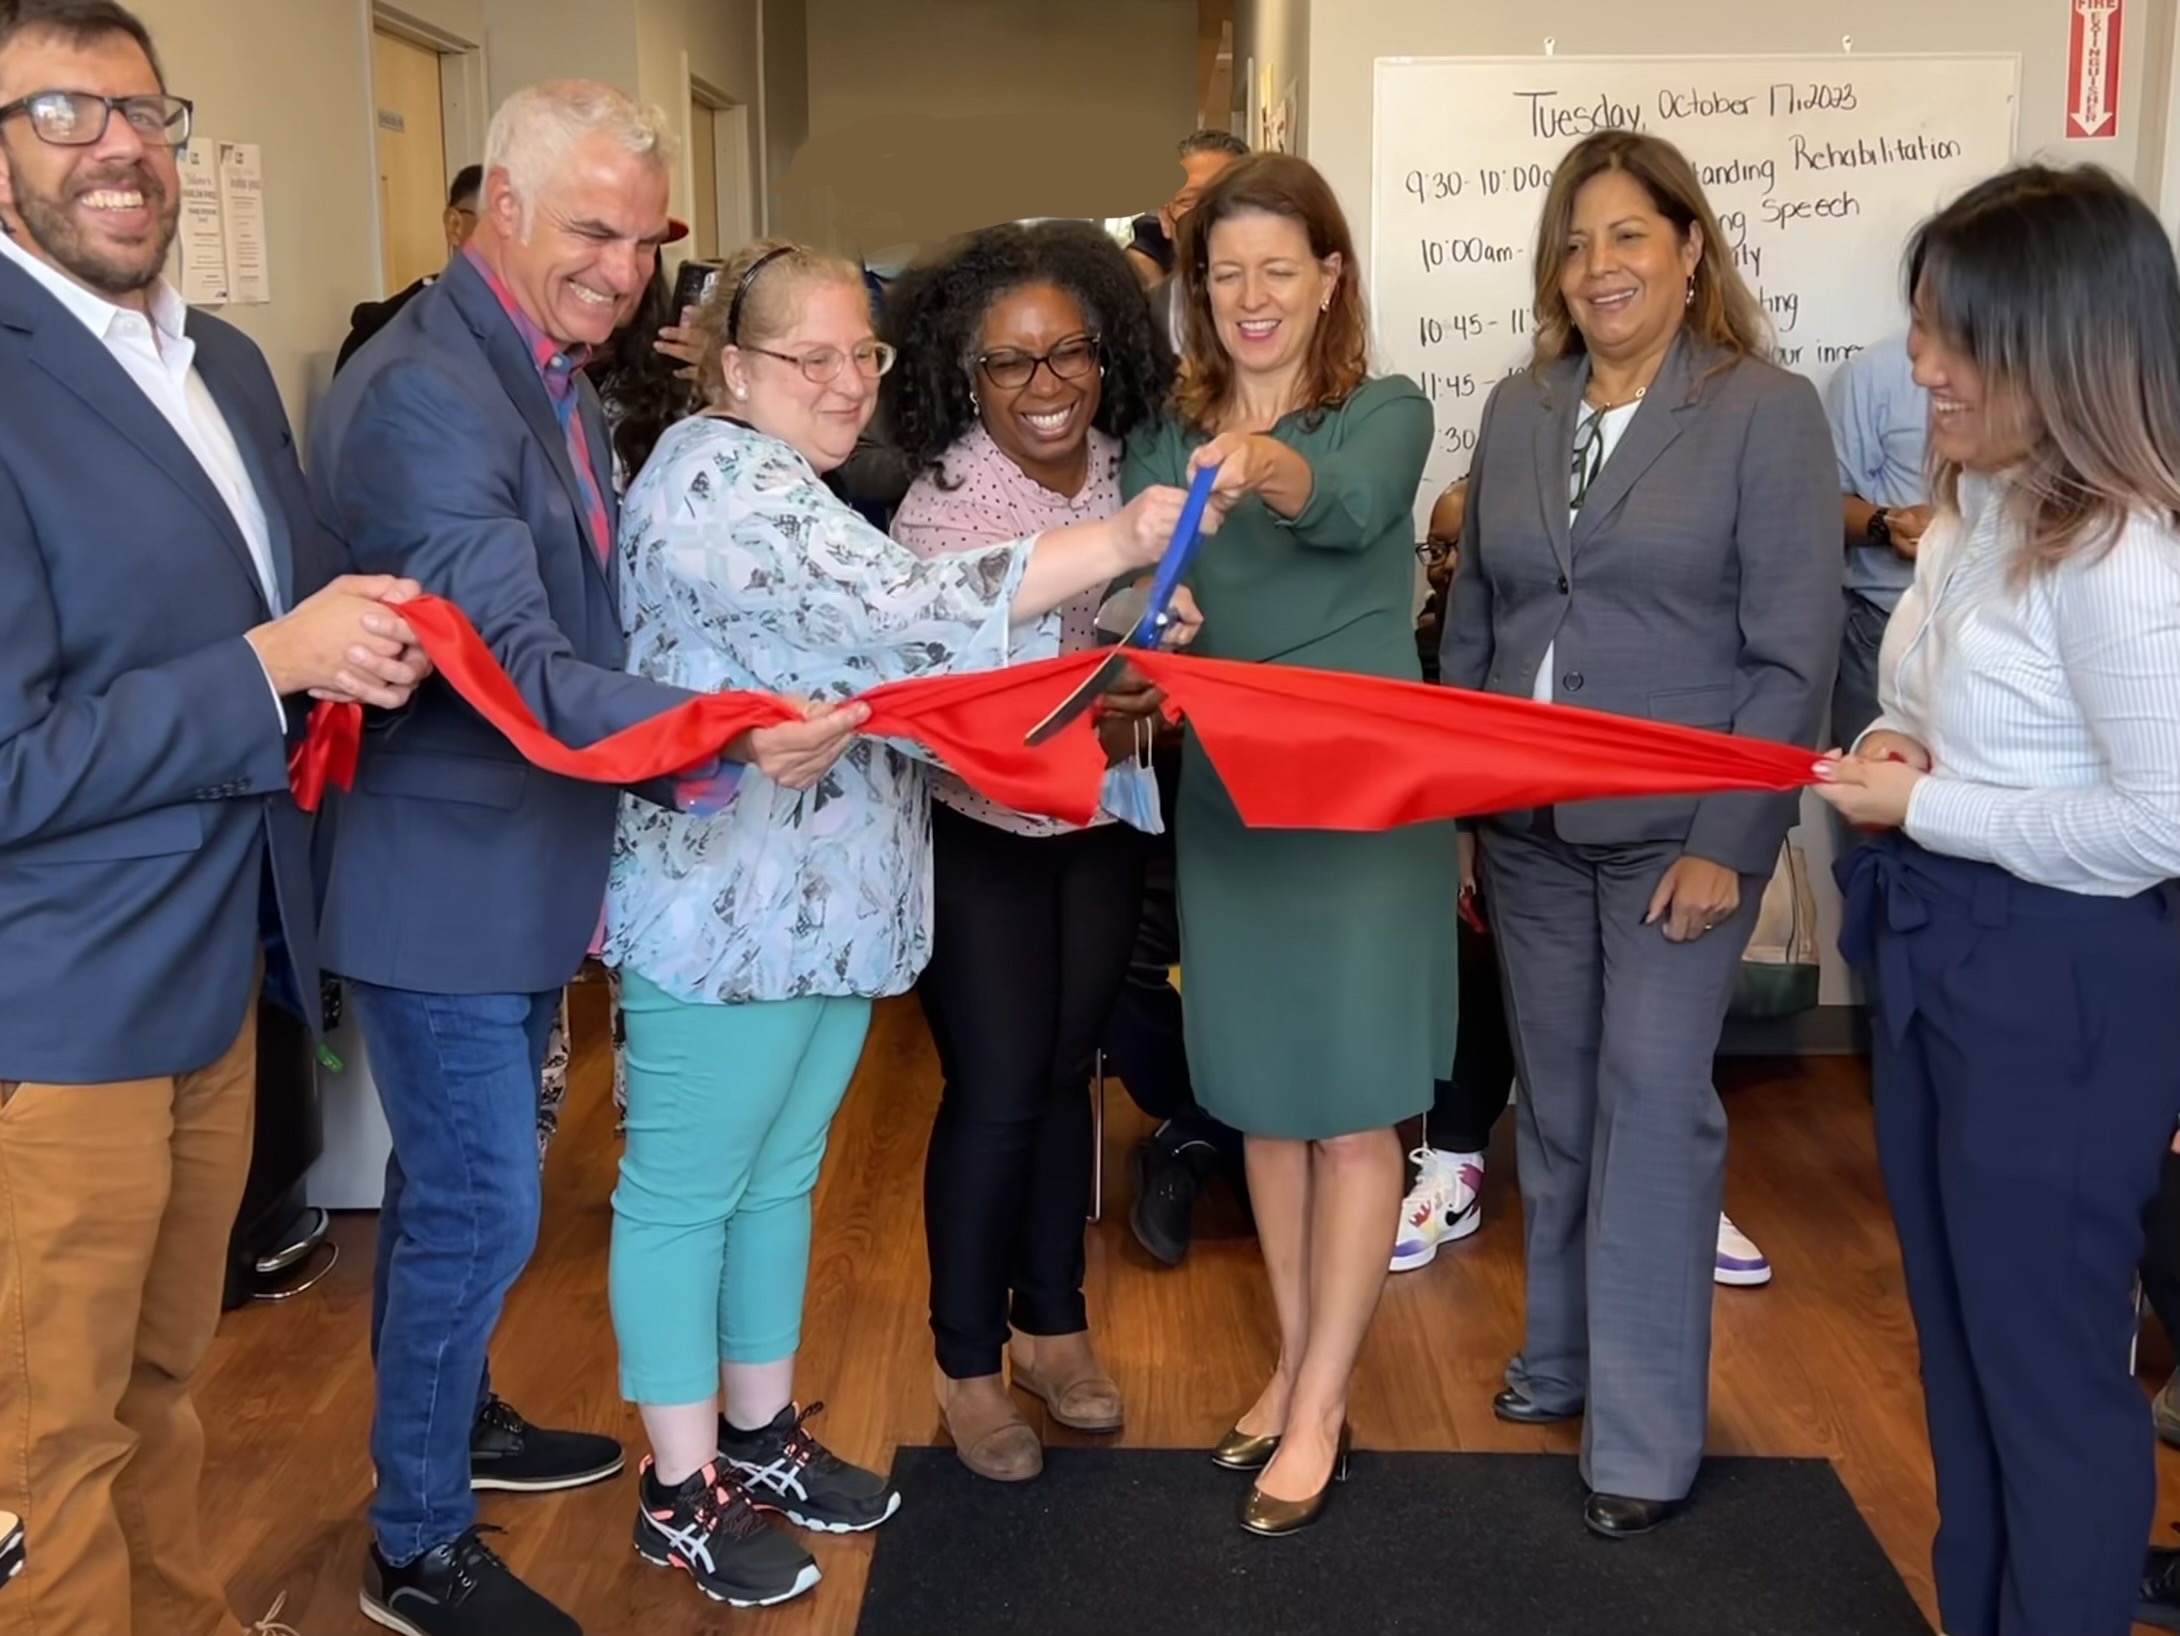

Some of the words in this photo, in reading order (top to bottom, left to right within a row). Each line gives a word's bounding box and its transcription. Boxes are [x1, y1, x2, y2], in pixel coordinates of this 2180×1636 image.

[1513, 91, 1647, 137] Tuesday,
[1658, 88, 1757, 120] October
[1788, 133, 1961, 171] Rehabilitation
[1761, 191, 1860, 230] Speech
